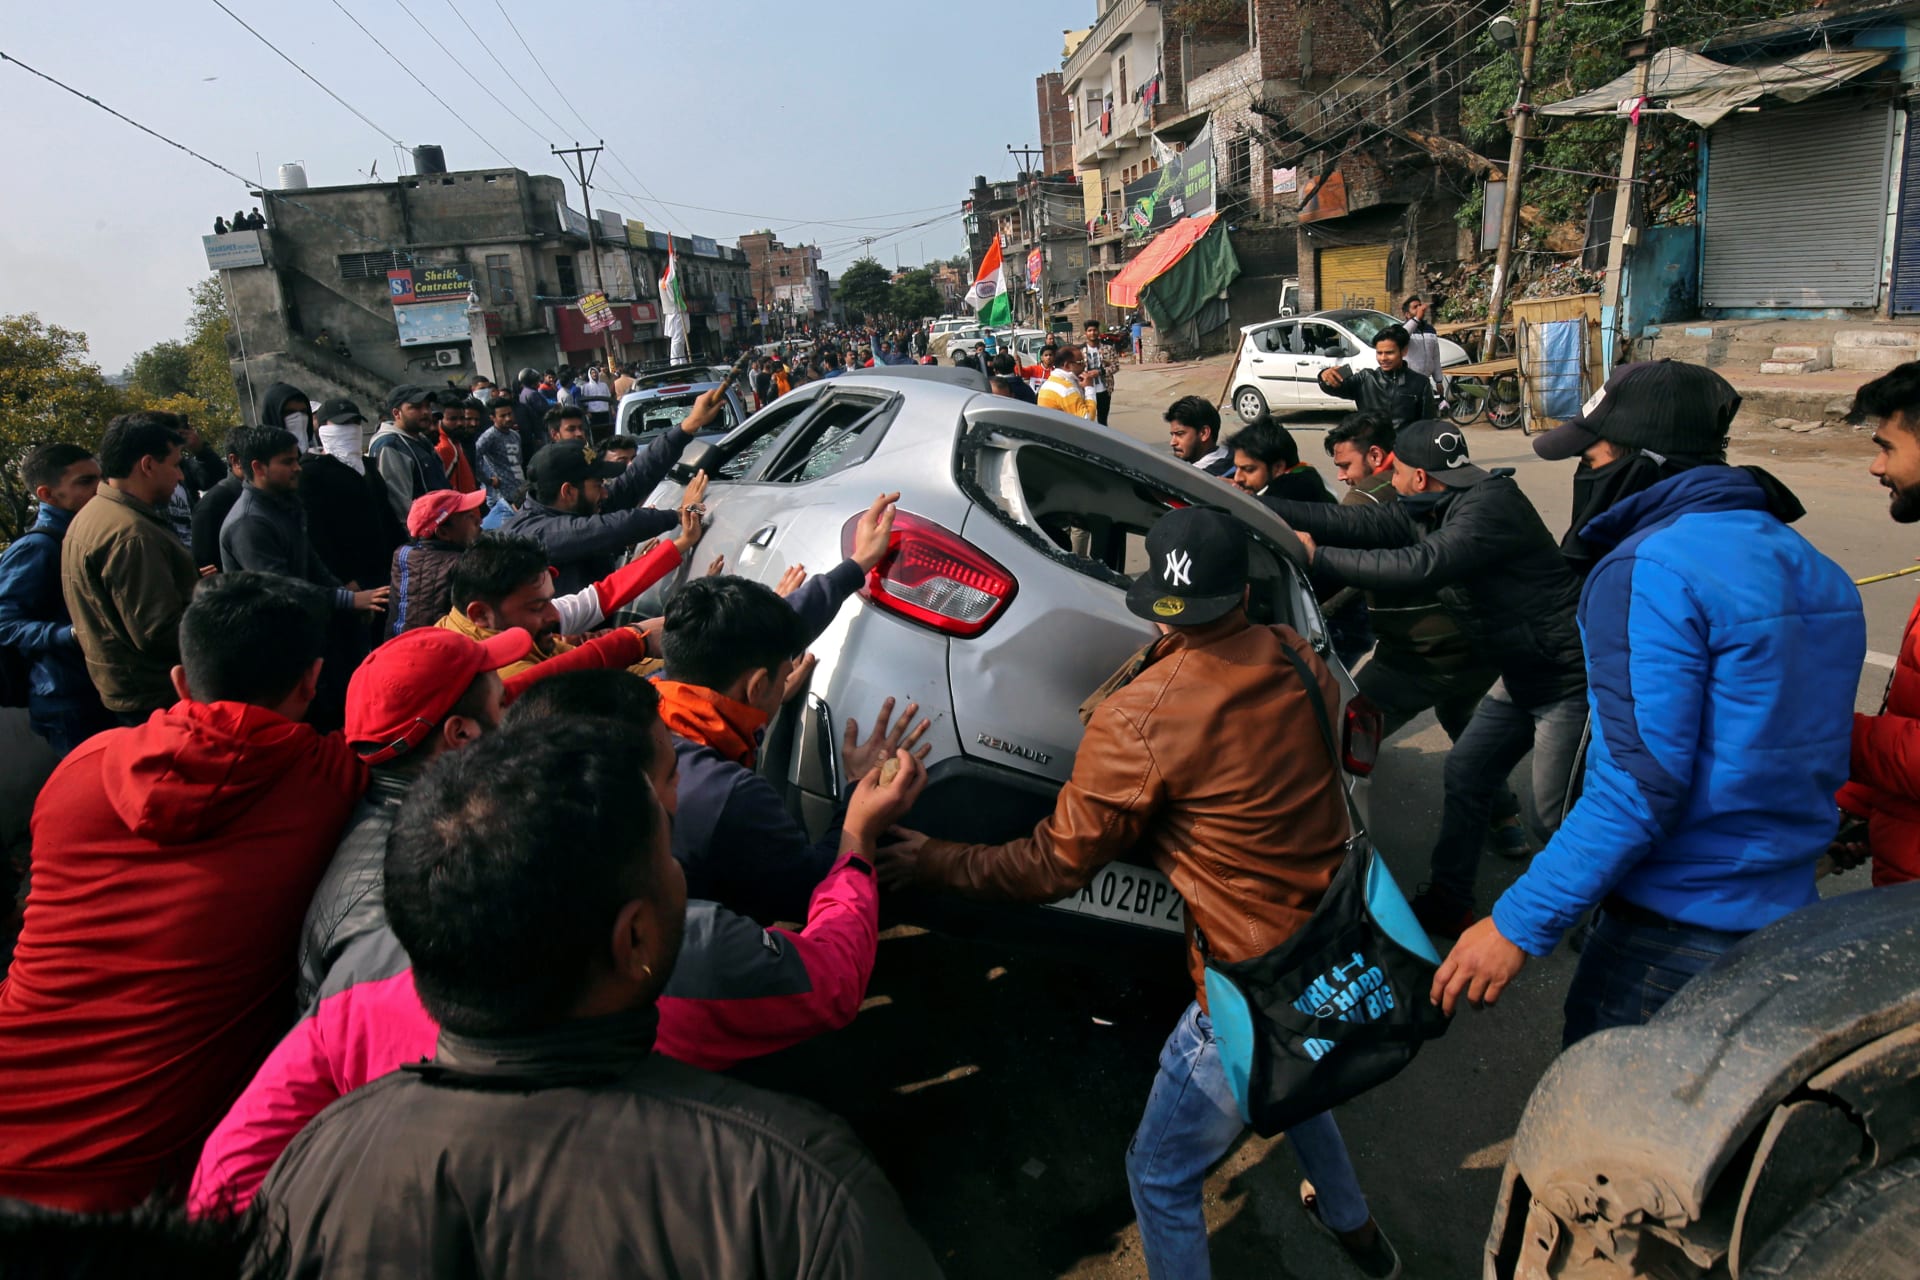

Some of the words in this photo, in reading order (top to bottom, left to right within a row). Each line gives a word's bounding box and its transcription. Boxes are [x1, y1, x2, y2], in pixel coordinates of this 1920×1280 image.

[424, 268, 459, 282] Sheikh
[1163, 548, 1192, 587] NY
[976, 732, 1053, 765] RENAULT
[1333, 966, 1384, 1011] HARD
[1364, 985, 1395, 1019] BIG
